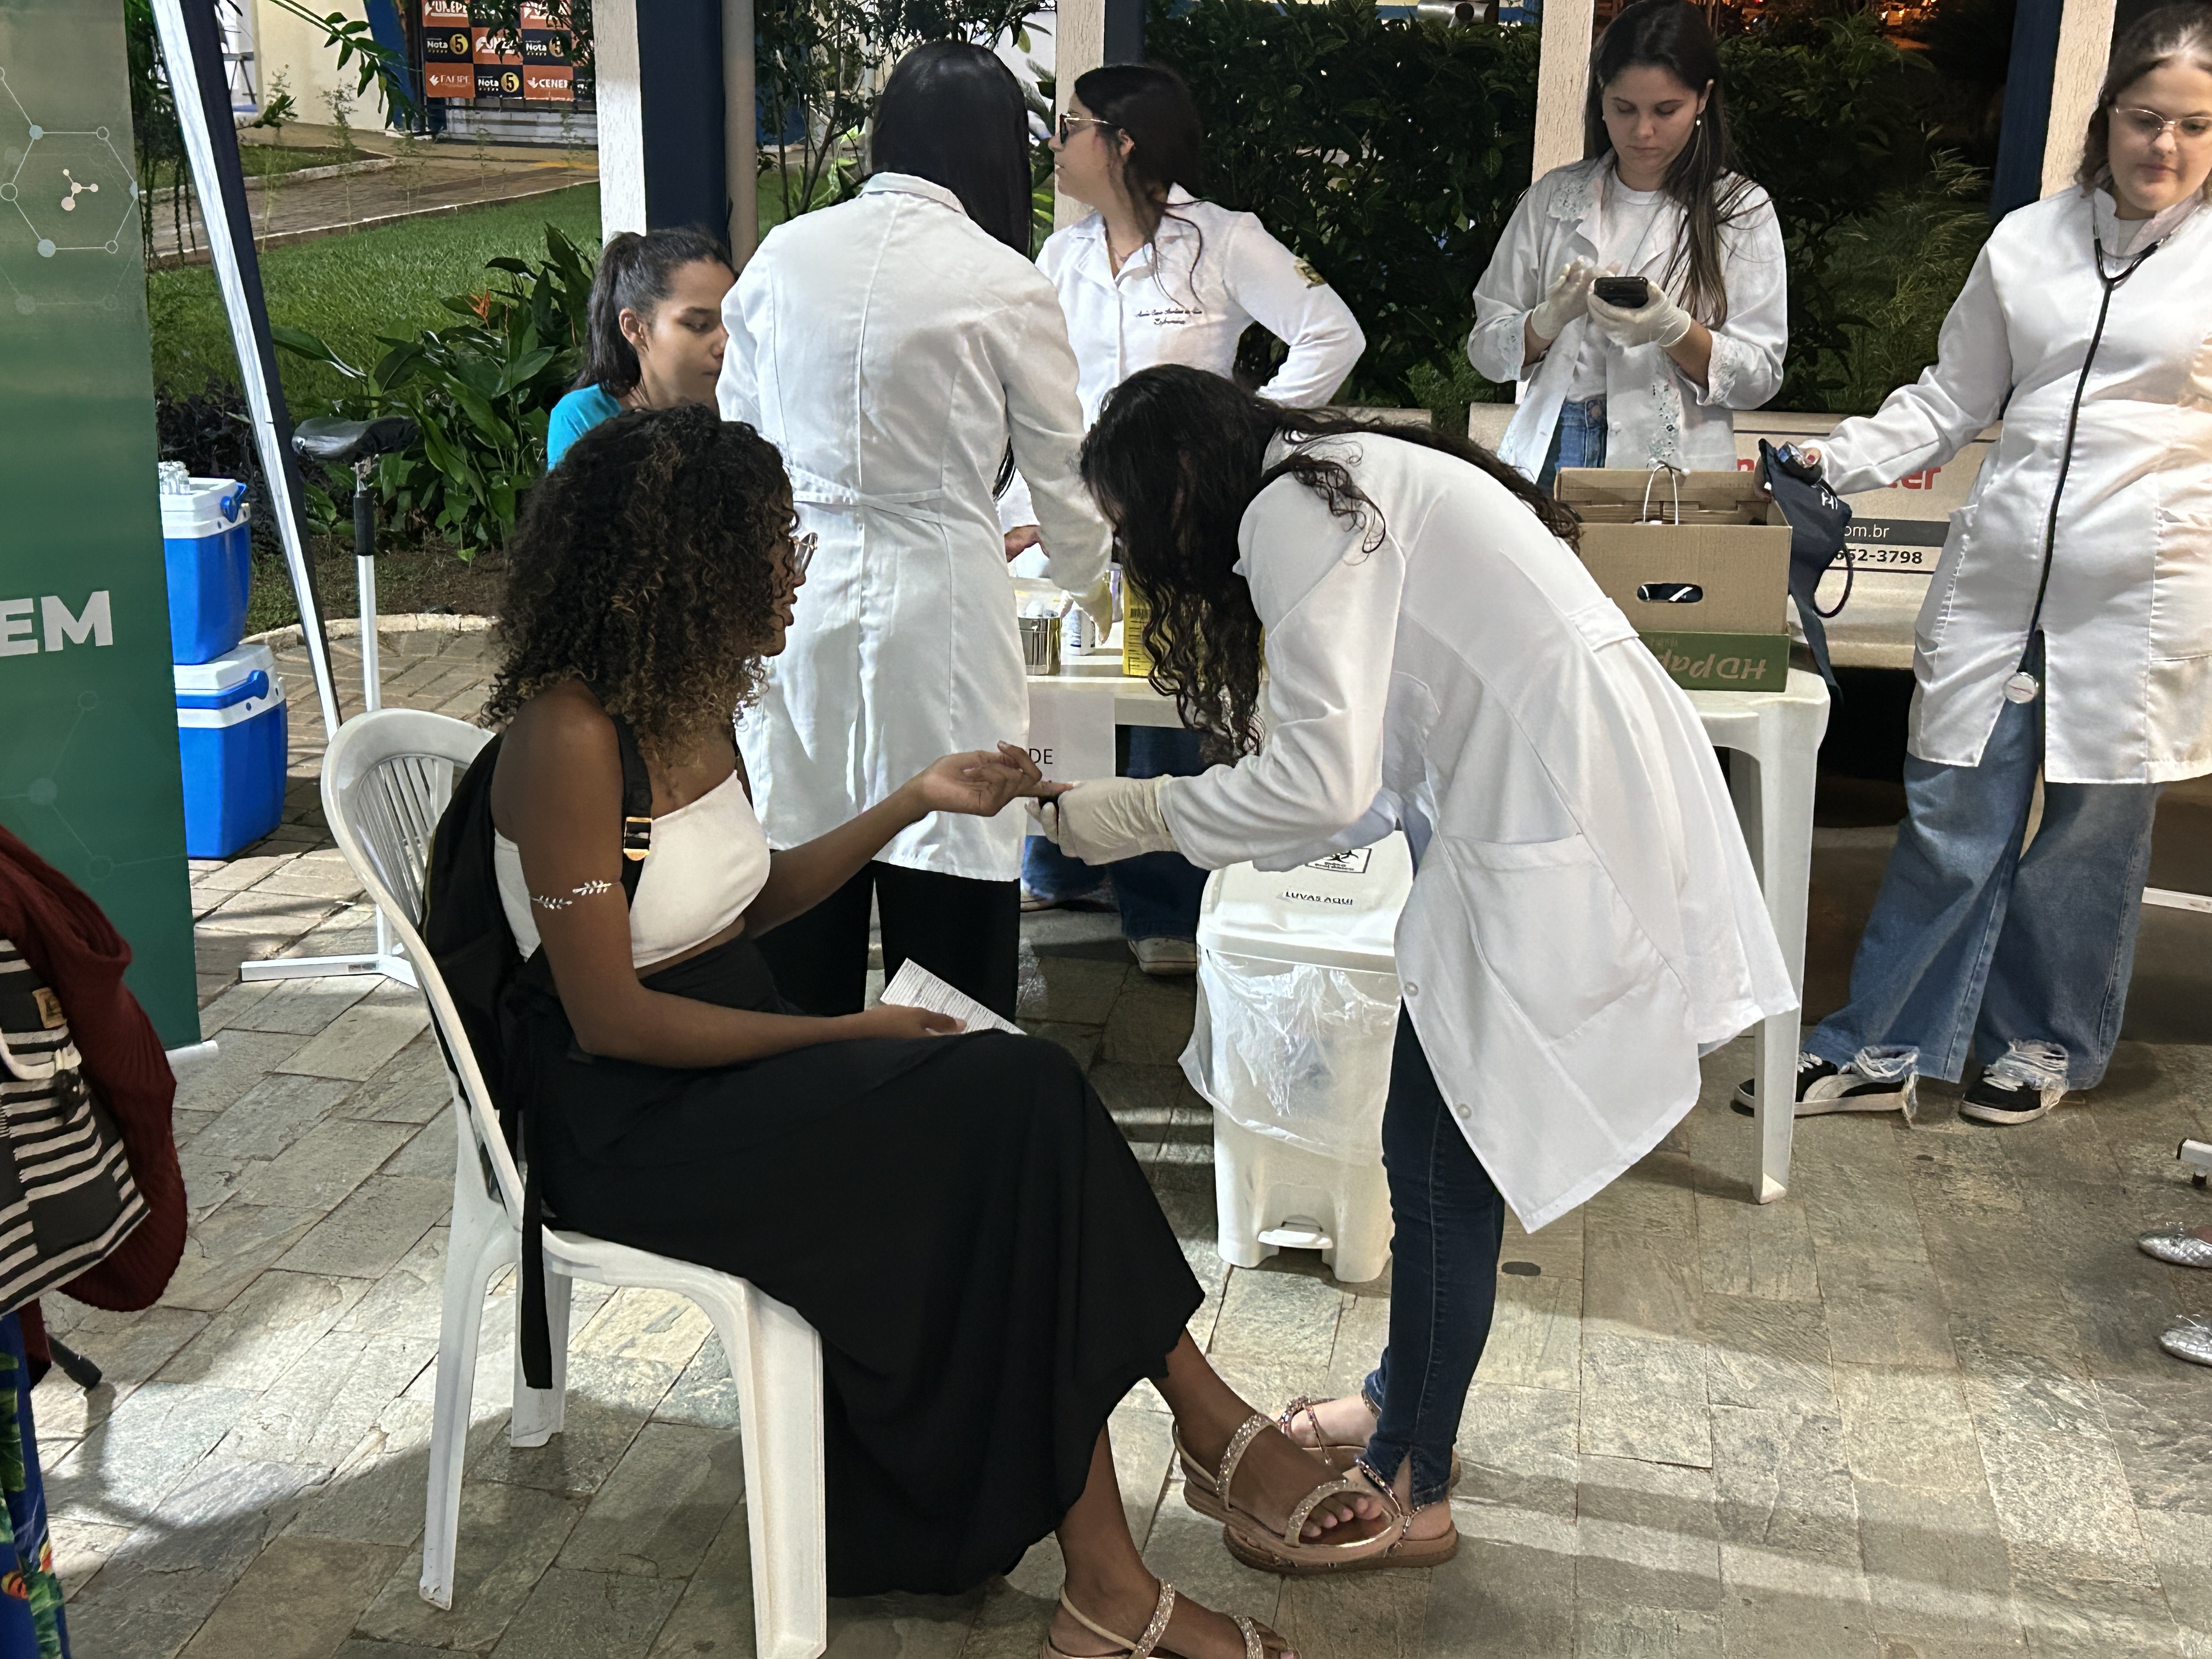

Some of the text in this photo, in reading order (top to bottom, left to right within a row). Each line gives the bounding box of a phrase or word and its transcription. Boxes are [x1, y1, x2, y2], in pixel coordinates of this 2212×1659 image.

[427, 41, 448, 49] Nota
[455, 36, 463, 52] 5
[526, 43, 547, 52] Nota
[478, 74, 514, 91] Nota 5
[0, 590, 113, 657] EM
[1285, 891, 1353, 905] LUVAS AQUI
